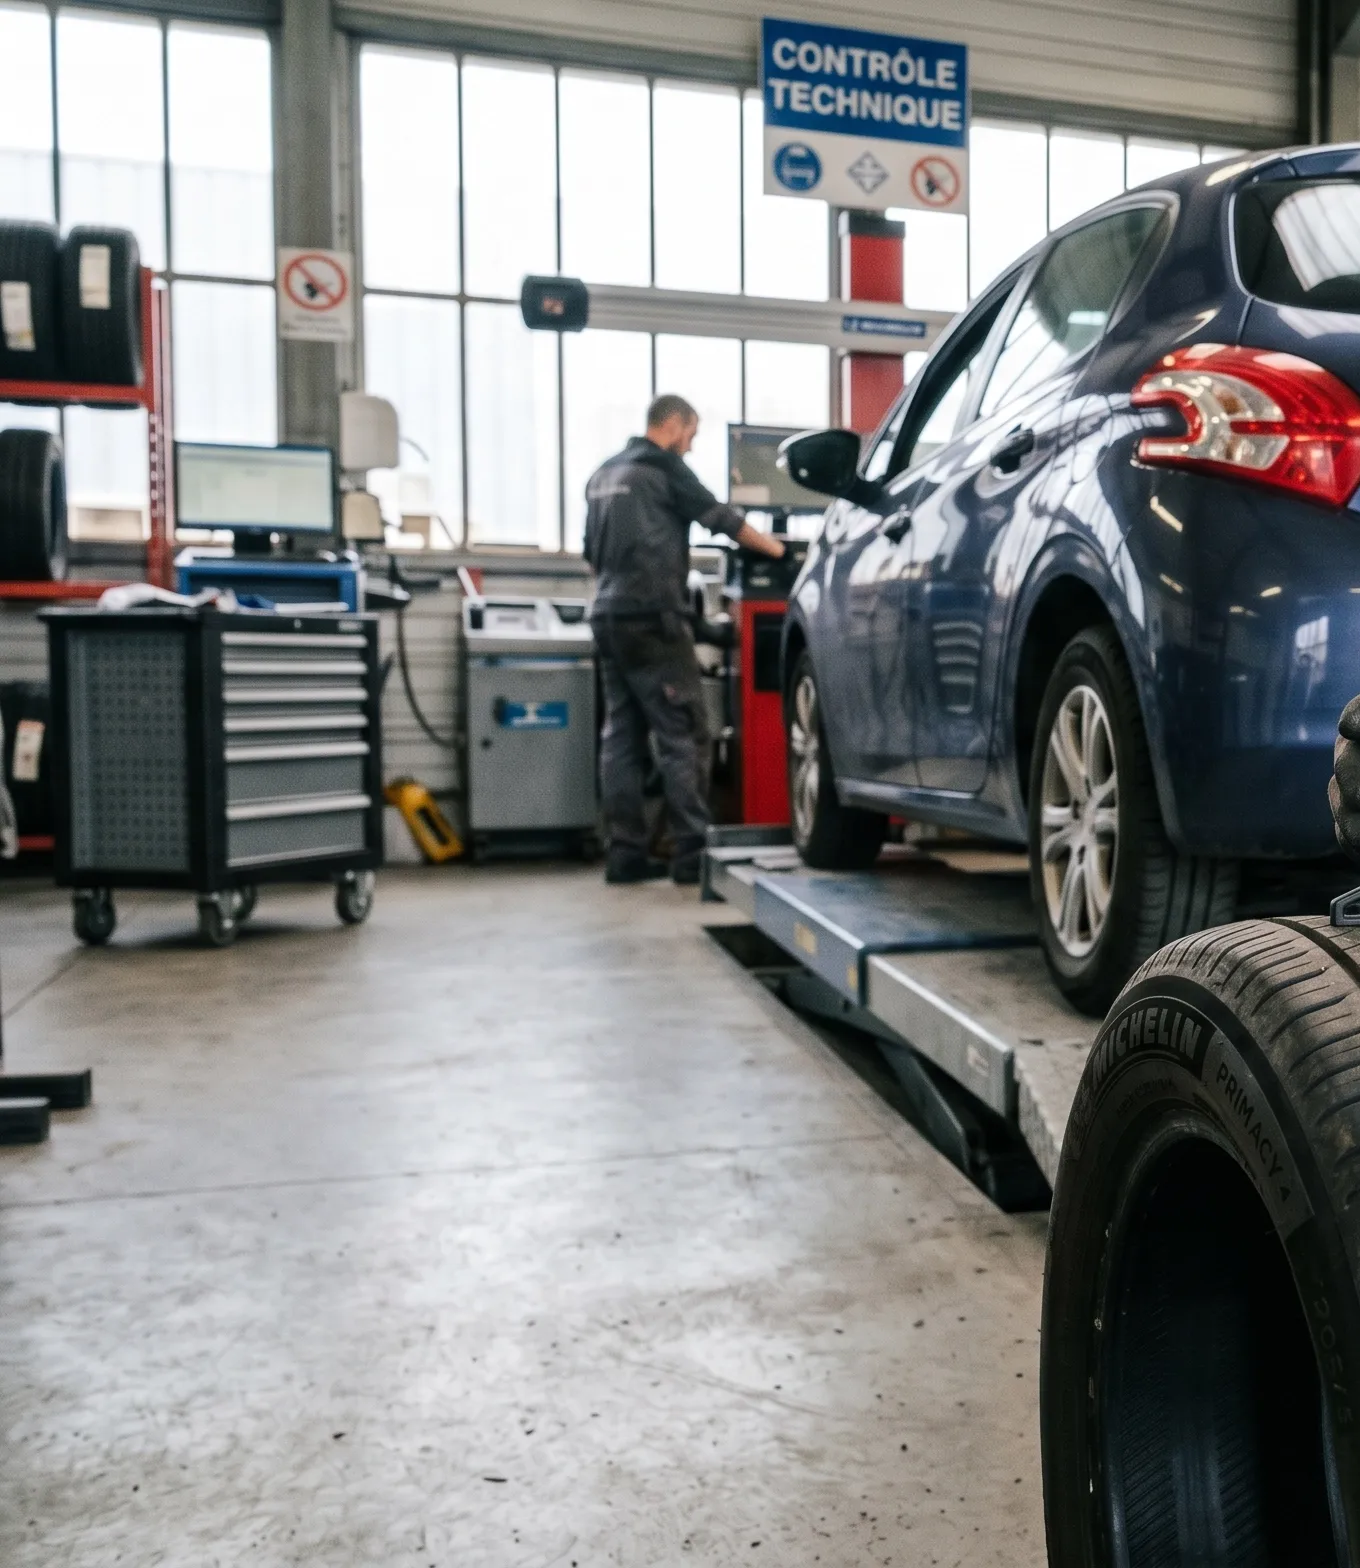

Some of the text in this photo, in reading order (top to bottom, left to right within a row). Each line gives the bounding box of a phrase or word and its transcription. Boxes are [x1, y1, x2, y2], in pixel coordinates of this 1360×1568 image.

[772, 37, 958, 91] CONTRÔLE
[767, 77, 962, 131] TECHNIQUE
[1092, 1007, 1202, 1091] MICHELIN
[1216, 1062, 1284, 1178] PRIMACY
